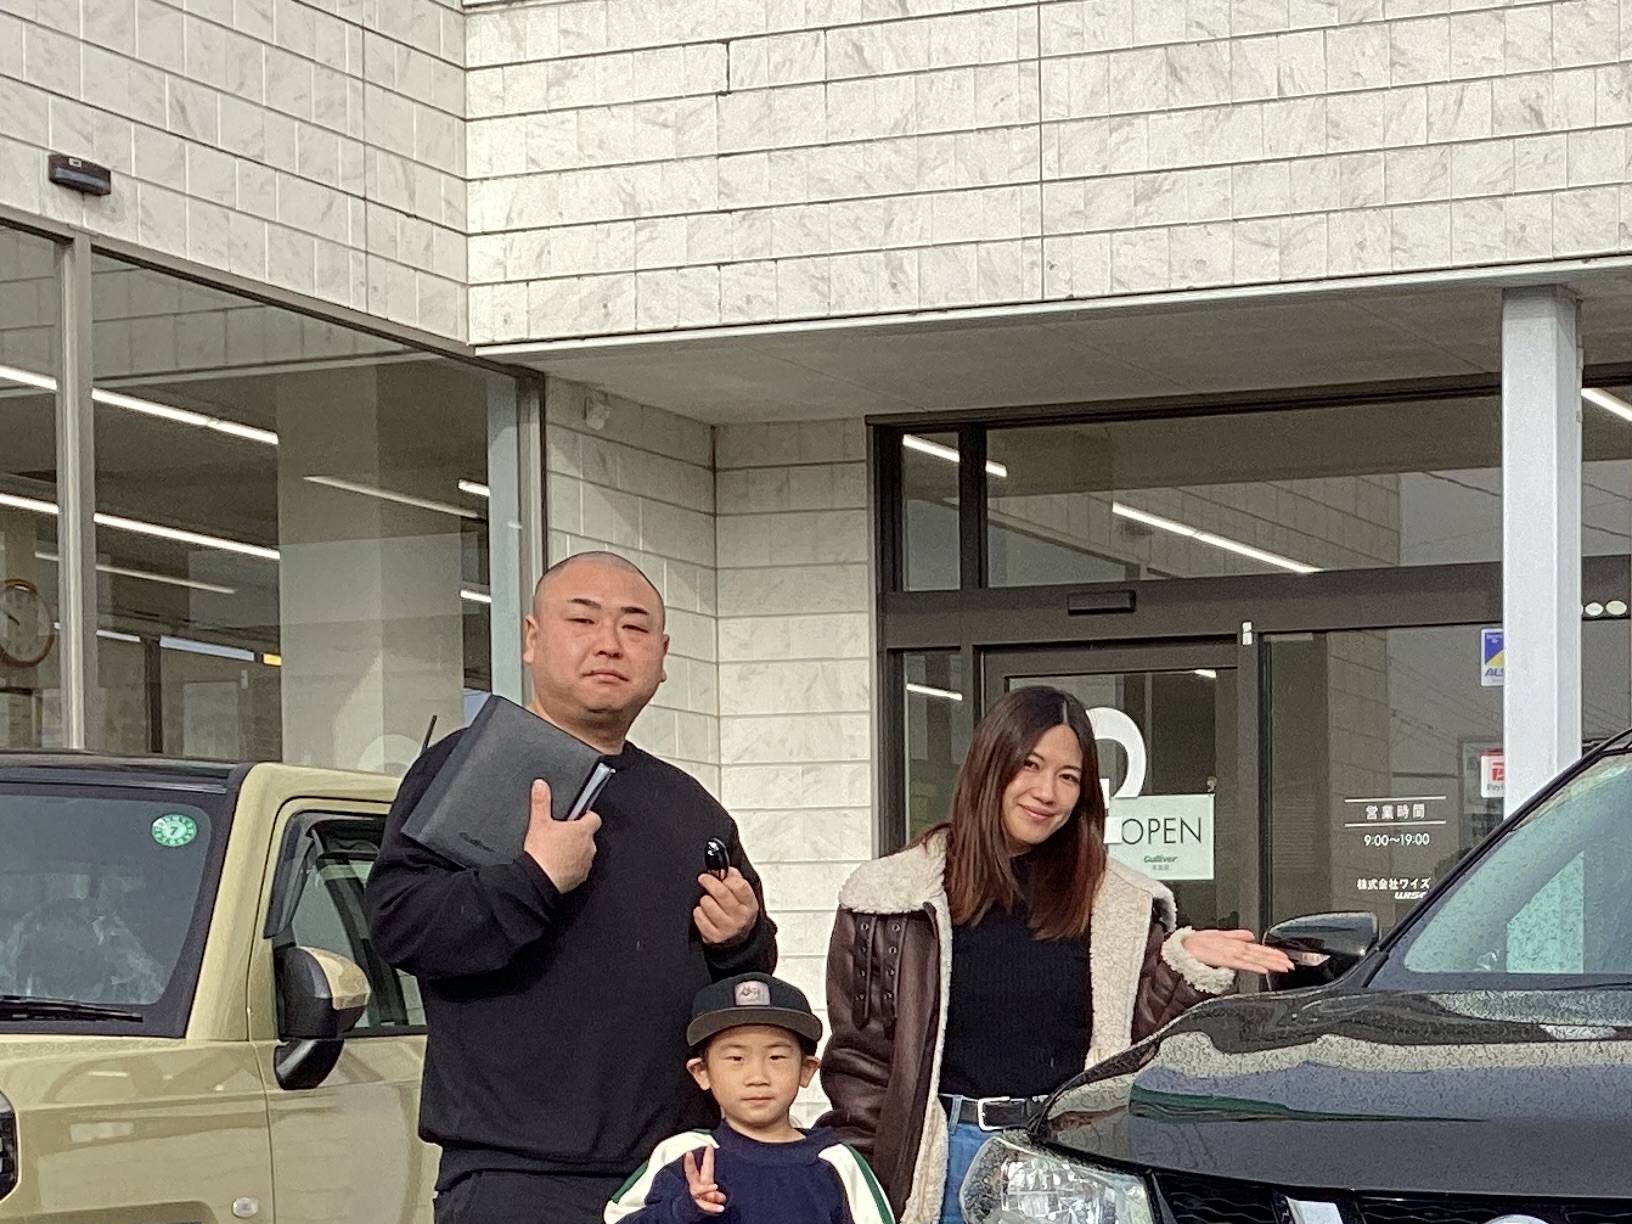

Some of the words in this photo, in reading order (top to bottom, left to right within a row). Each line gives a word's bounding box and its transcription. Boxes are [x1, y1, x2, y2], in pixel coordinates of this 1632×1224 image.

[1365, 804, 1425, 820] 営業時間
[1121, 817, 1203, 845] OPEN
